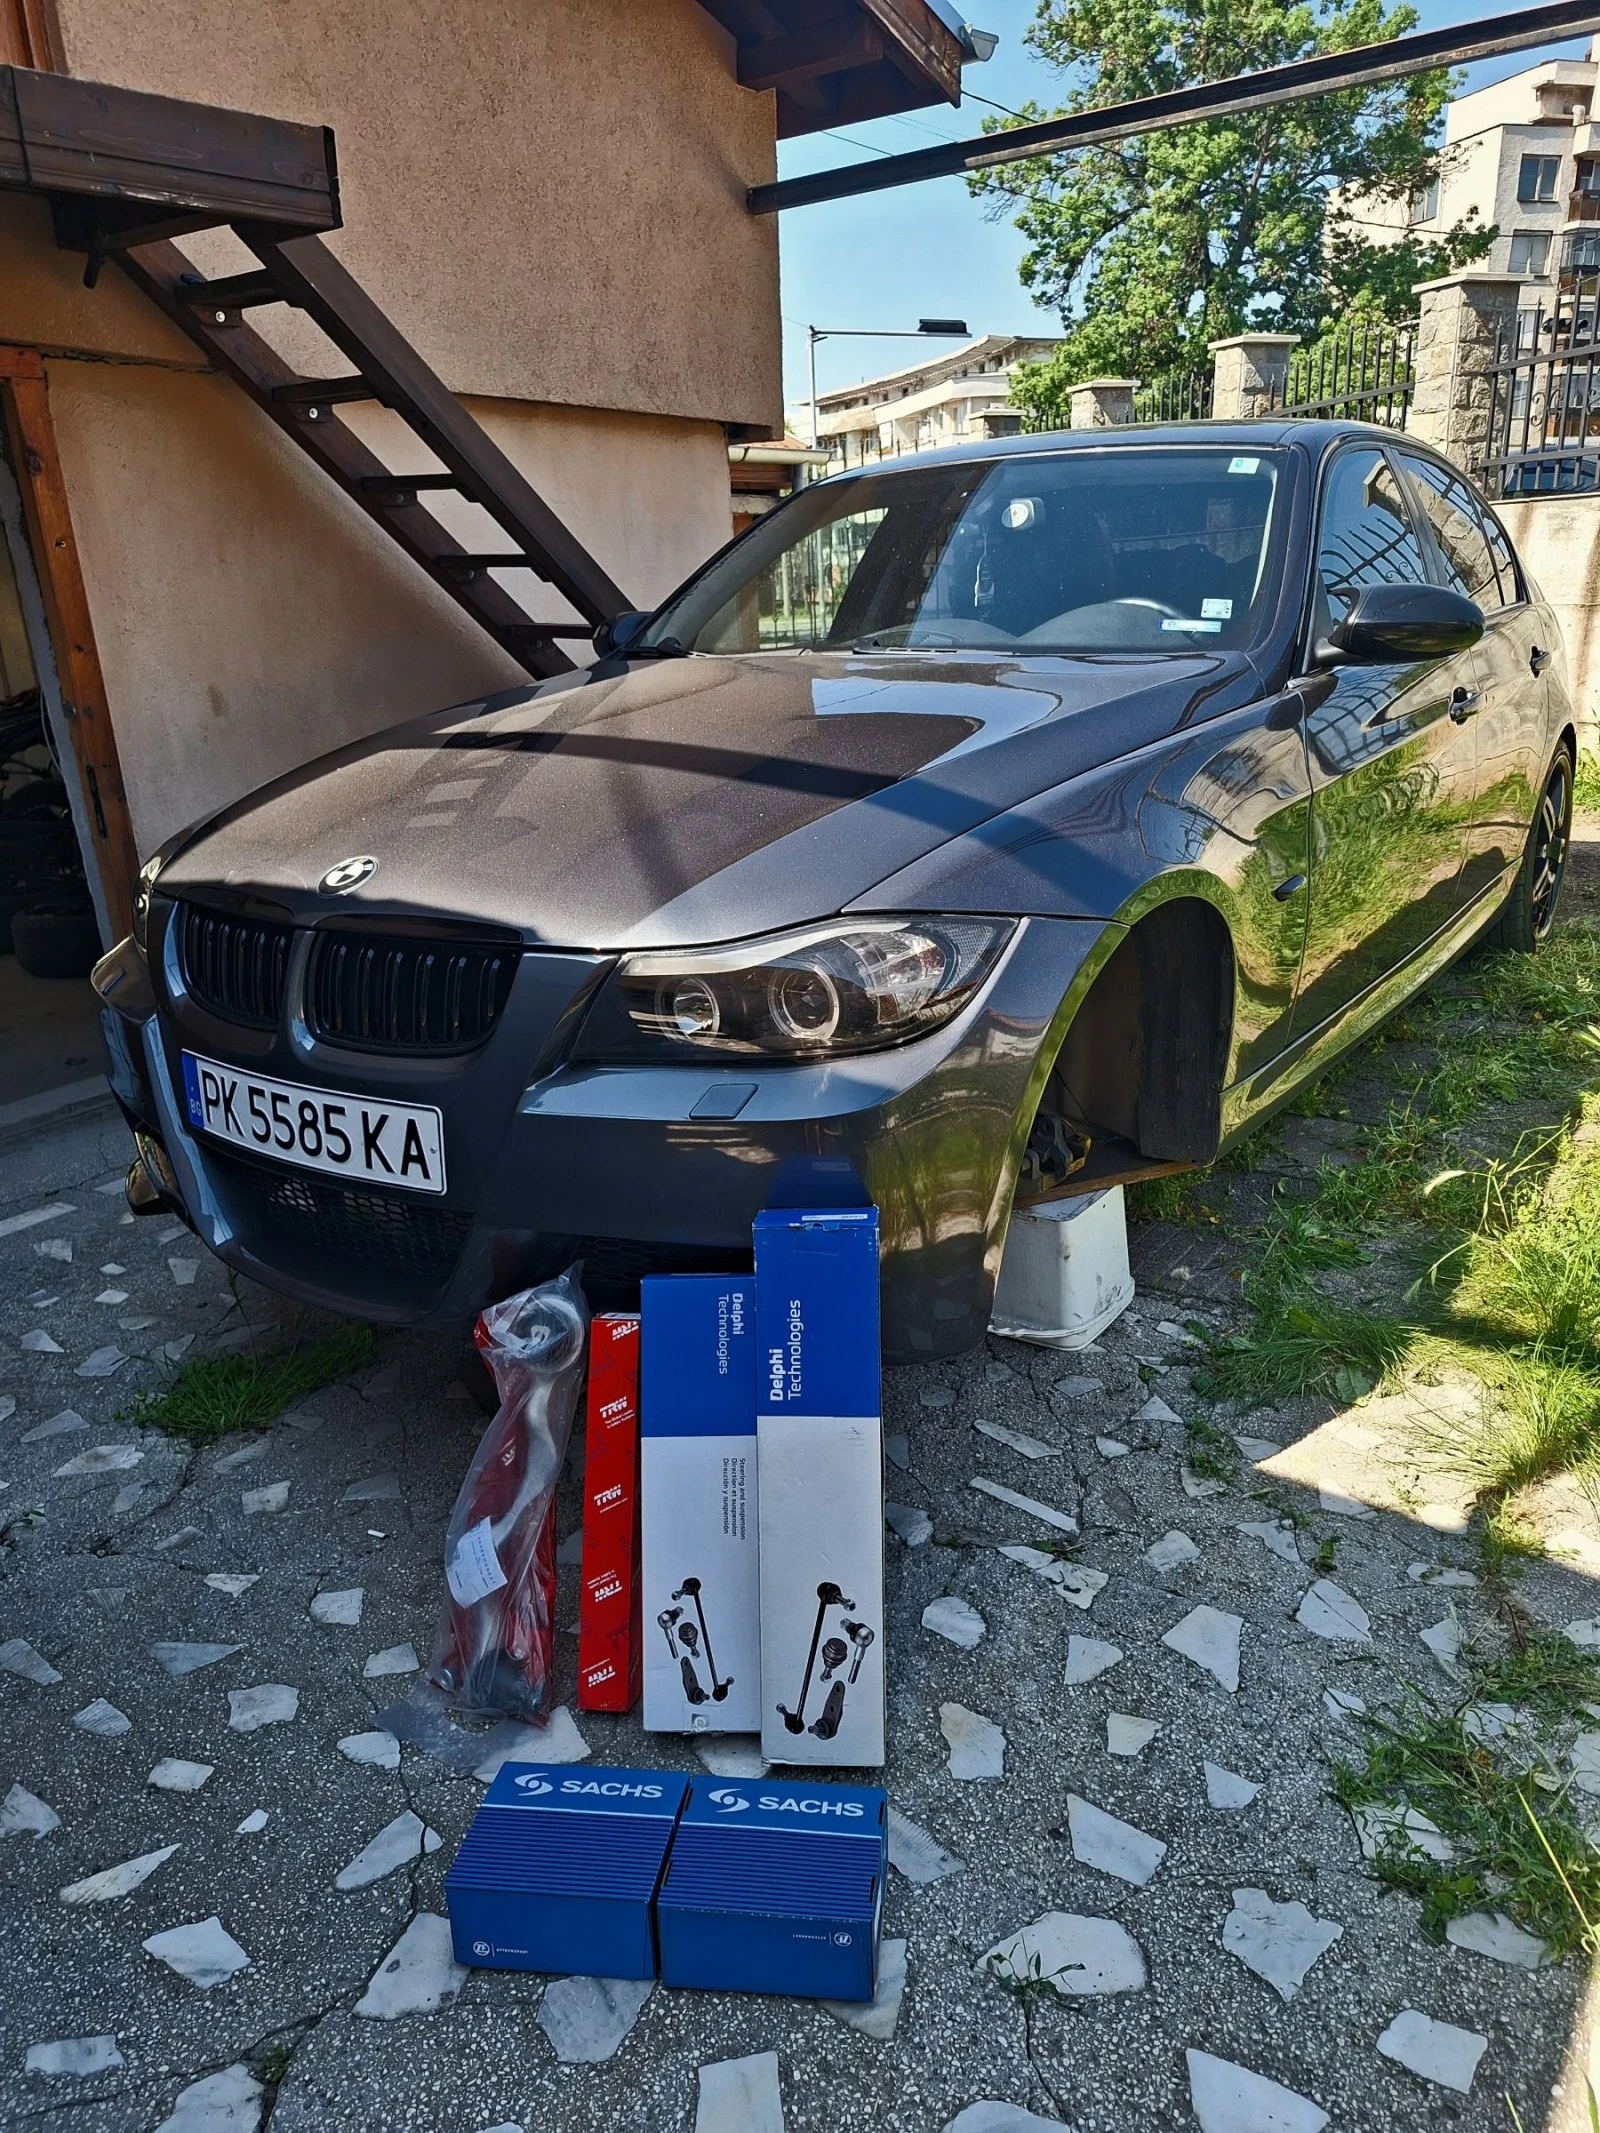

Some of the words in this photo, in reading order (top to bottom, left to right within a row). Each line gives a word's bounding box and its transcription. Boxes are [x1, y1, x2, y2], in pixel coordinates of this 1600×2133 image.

[190, 1100, 202, 1117] BG
[201, 1069, 245, 1137] PK
[248, 1084, 352, 1164] 5585
[361, 1110, 432, 1180] KA
[731, 1293, 744, 1335] Delphi
[717, 1294, 730, 1375] Technologies
[787, 1299, 804, 1401] Technologies
[769, 1348, 786, 1401] Delphi
[599, 1396, 627, 1418] TRW
[738, 1457, 746, 1486] Steering
[594, 1483, 622, 1506] TRW
[731, 1489, 737, 1497] et
[730, 1499, 738, 1537] suspension
[595, 1580, 622, 1603] TRW
[588, 1665, 616, 1688] TRW
[560, 1780, 663, 1798] SACHS
[758, 1796, 864, 1817] SACHS
